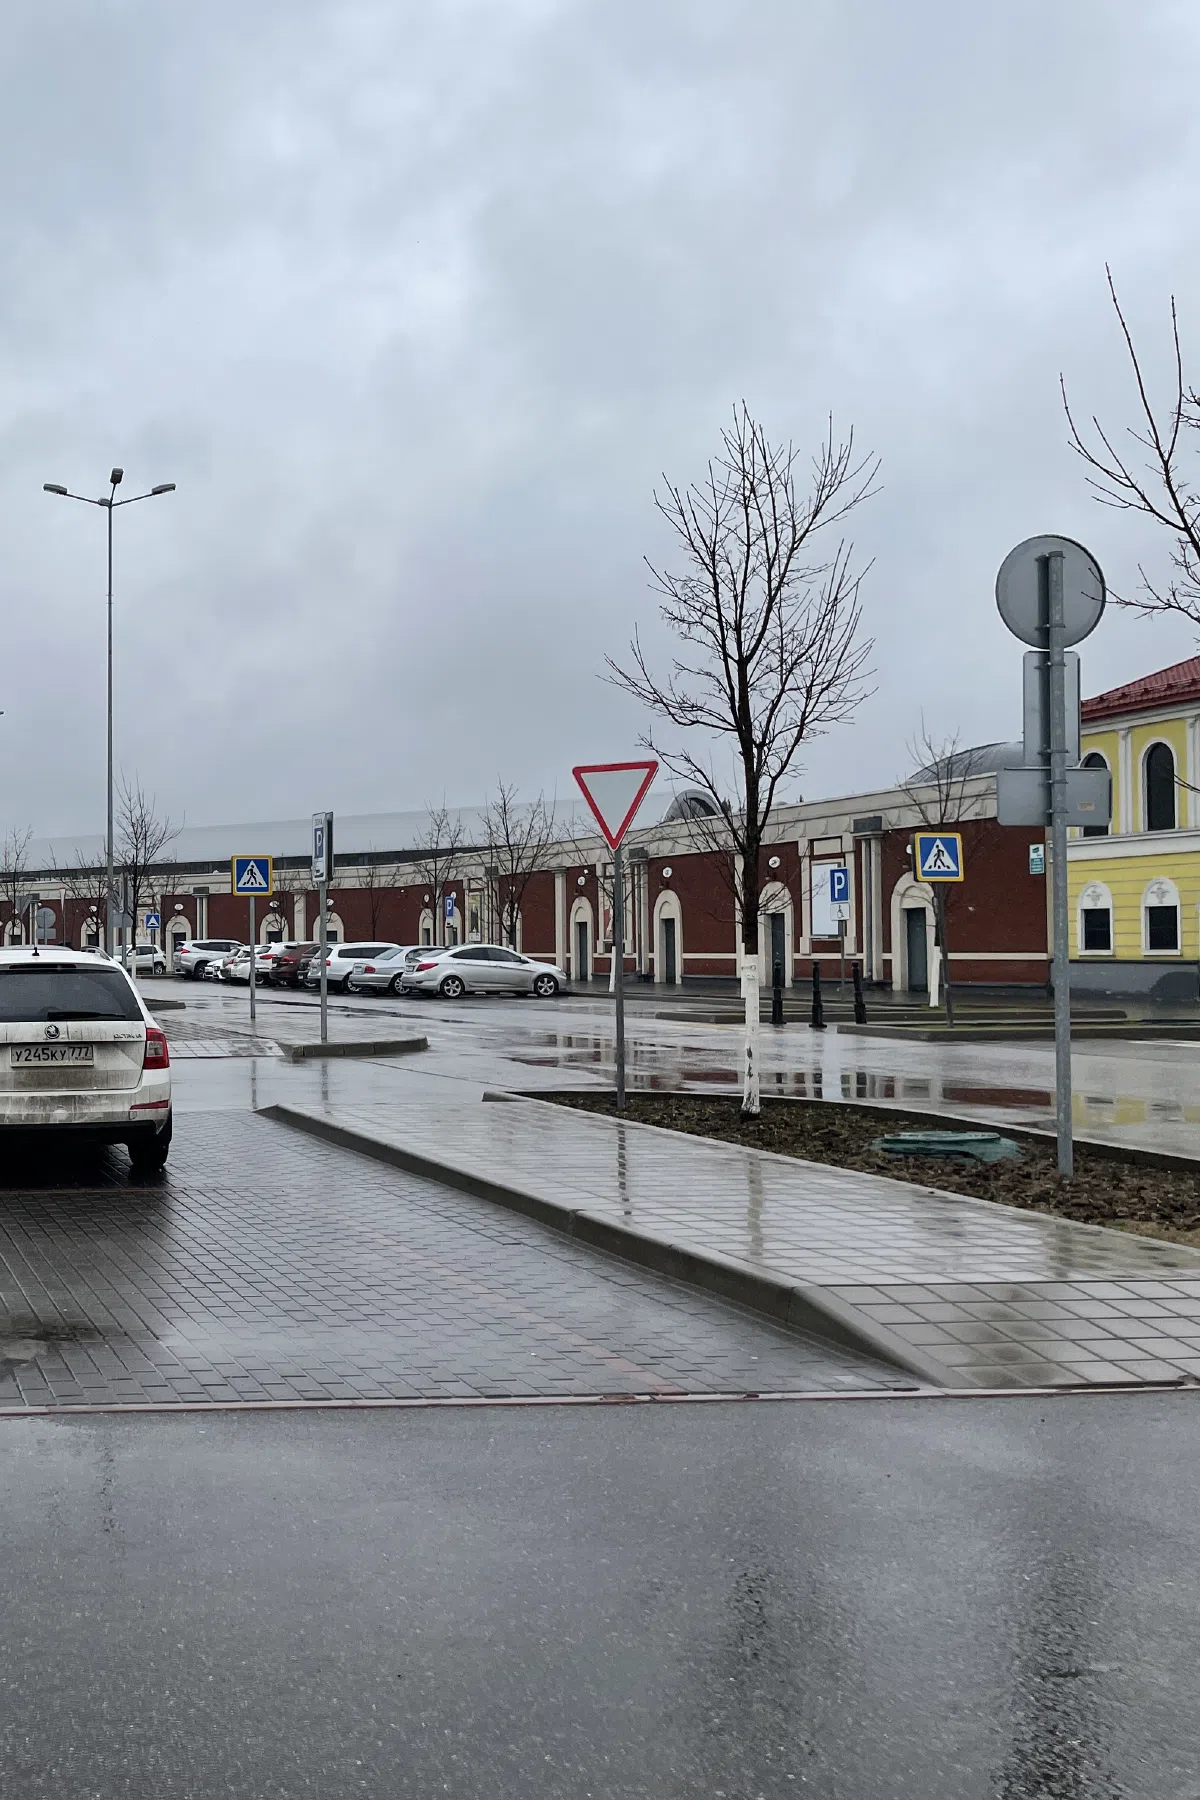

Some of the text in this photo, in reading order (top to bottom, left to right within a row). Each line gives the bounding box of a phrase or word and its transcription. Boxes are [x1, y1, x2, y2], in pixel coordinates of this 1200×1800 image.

[317, 831, 322, 856] P
[834, 872, 845, 899] P
[447, 900, 452, 915] P
[15, 1046, 90, 1062] У245КУ 777
